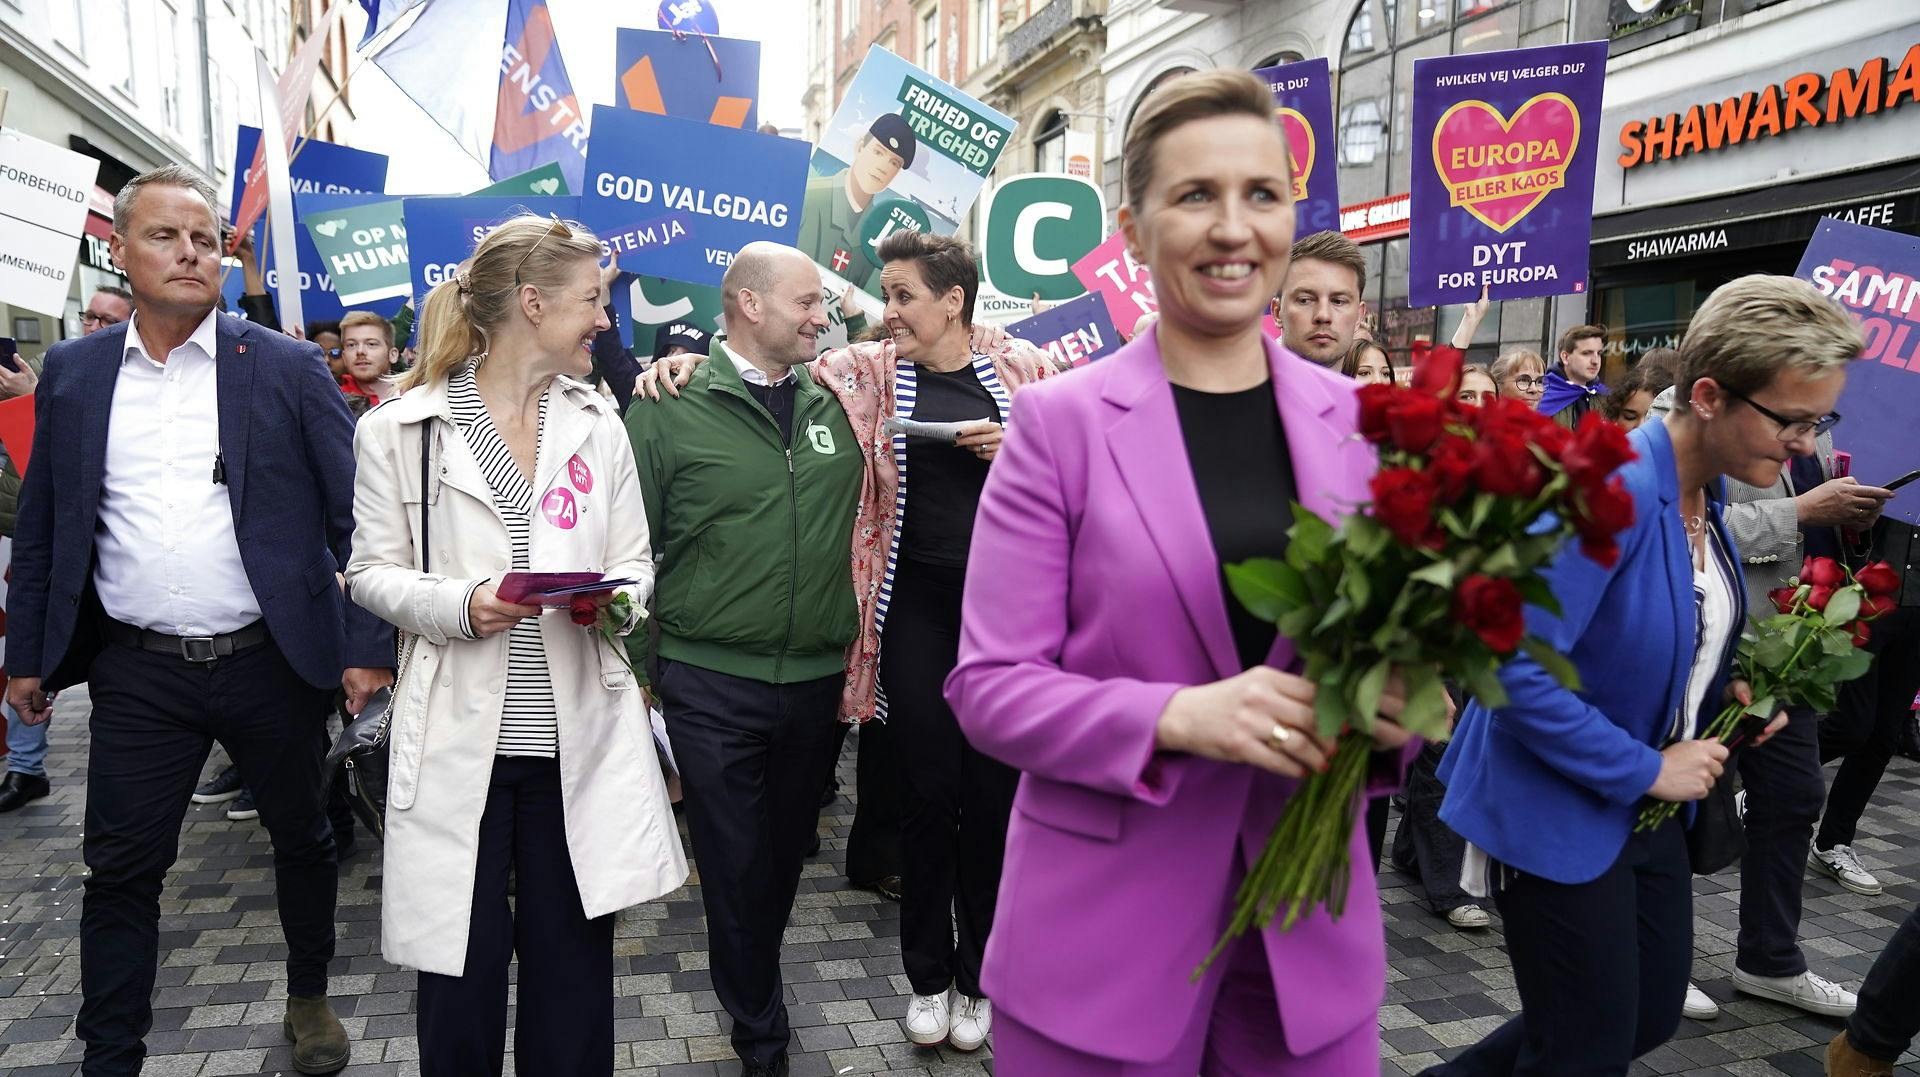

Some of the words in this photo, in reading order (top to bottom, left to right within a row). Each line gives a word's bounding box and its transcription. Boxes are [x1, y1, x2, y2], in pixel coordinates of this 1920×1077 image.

[1287, 77, 1309, 91] DU?
[1436, 71, 1487, 87] HVILKEN
[1490, 69, 1509, 83] VEJ
[1512, 65, 1560, 80] VÆLGER
[1562, 62, 1586, 75] DU?
[501, 43, 588, 158] ENSTR
[1617, 43, 1920, 168] SHAWARMA
[904, 84, 970, 131] FRIHED
[970, 122, 1001, 150] OG
[907, 110, 989, 168] TRYGHED
[1451, 139, 1561, 170] EUROPA
[0, 165, 85, 203] FORBEHOLD
[1455, 180, 1507, 201] ELLER
[1511, 170, 1559, 192] KAOS
[596, 172, 653, 204] GOD
[661, 183, 788, 228] VALGDAG
[890, 207, 921, 232] STEM
[352, 227, 386, 246] OP
[600, 227, 658, 257] STEM
[661, 219, 686, 245] JA
[1013, 201, 1073, 276] C
[1627, 229, 1728, 260] SHAWARMA
[86, 234, 113, 272] THE
[330, 243, 409, 276] HUM
[1472, 241, 1527, 267] DYT
[266, 269, 311, 290] GD
[1438, 271, 1476, 289] FOR
[1481, 264, 1558, 286] EUROPA
[815, 430, 829, 448] C
[547, 494, 574, 523] JA
